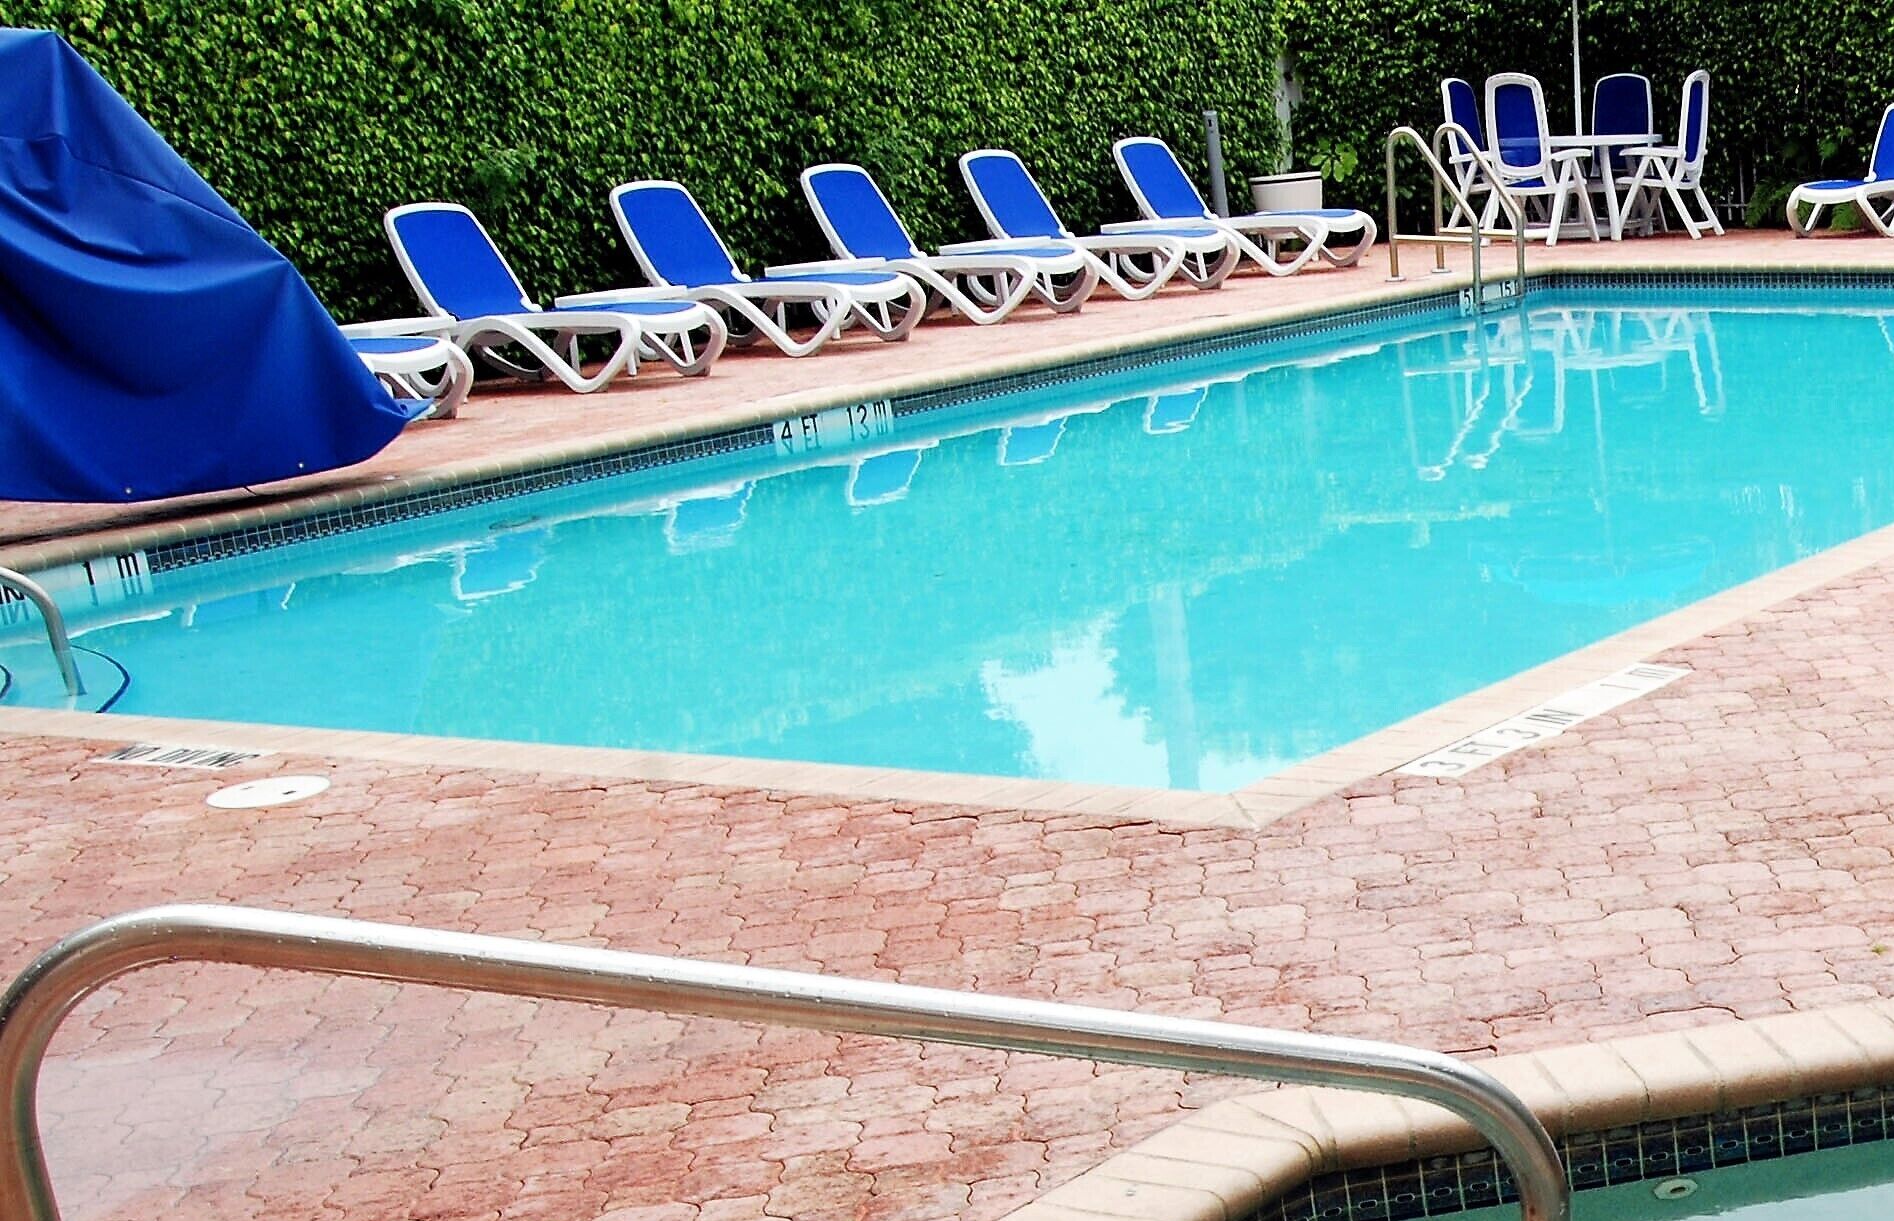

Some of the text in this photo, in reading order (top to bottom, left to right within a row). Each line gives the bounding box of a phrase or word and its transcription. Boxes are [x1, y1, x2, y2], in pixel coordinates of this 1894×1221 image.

[781, 420, 793, 440] 4
[801, 414, 818, 436] FT
[1420, 760, 1467, 771] 3
[1448, 741, 1508, 757] FT
[1496, 728, 1540, 739] 3
